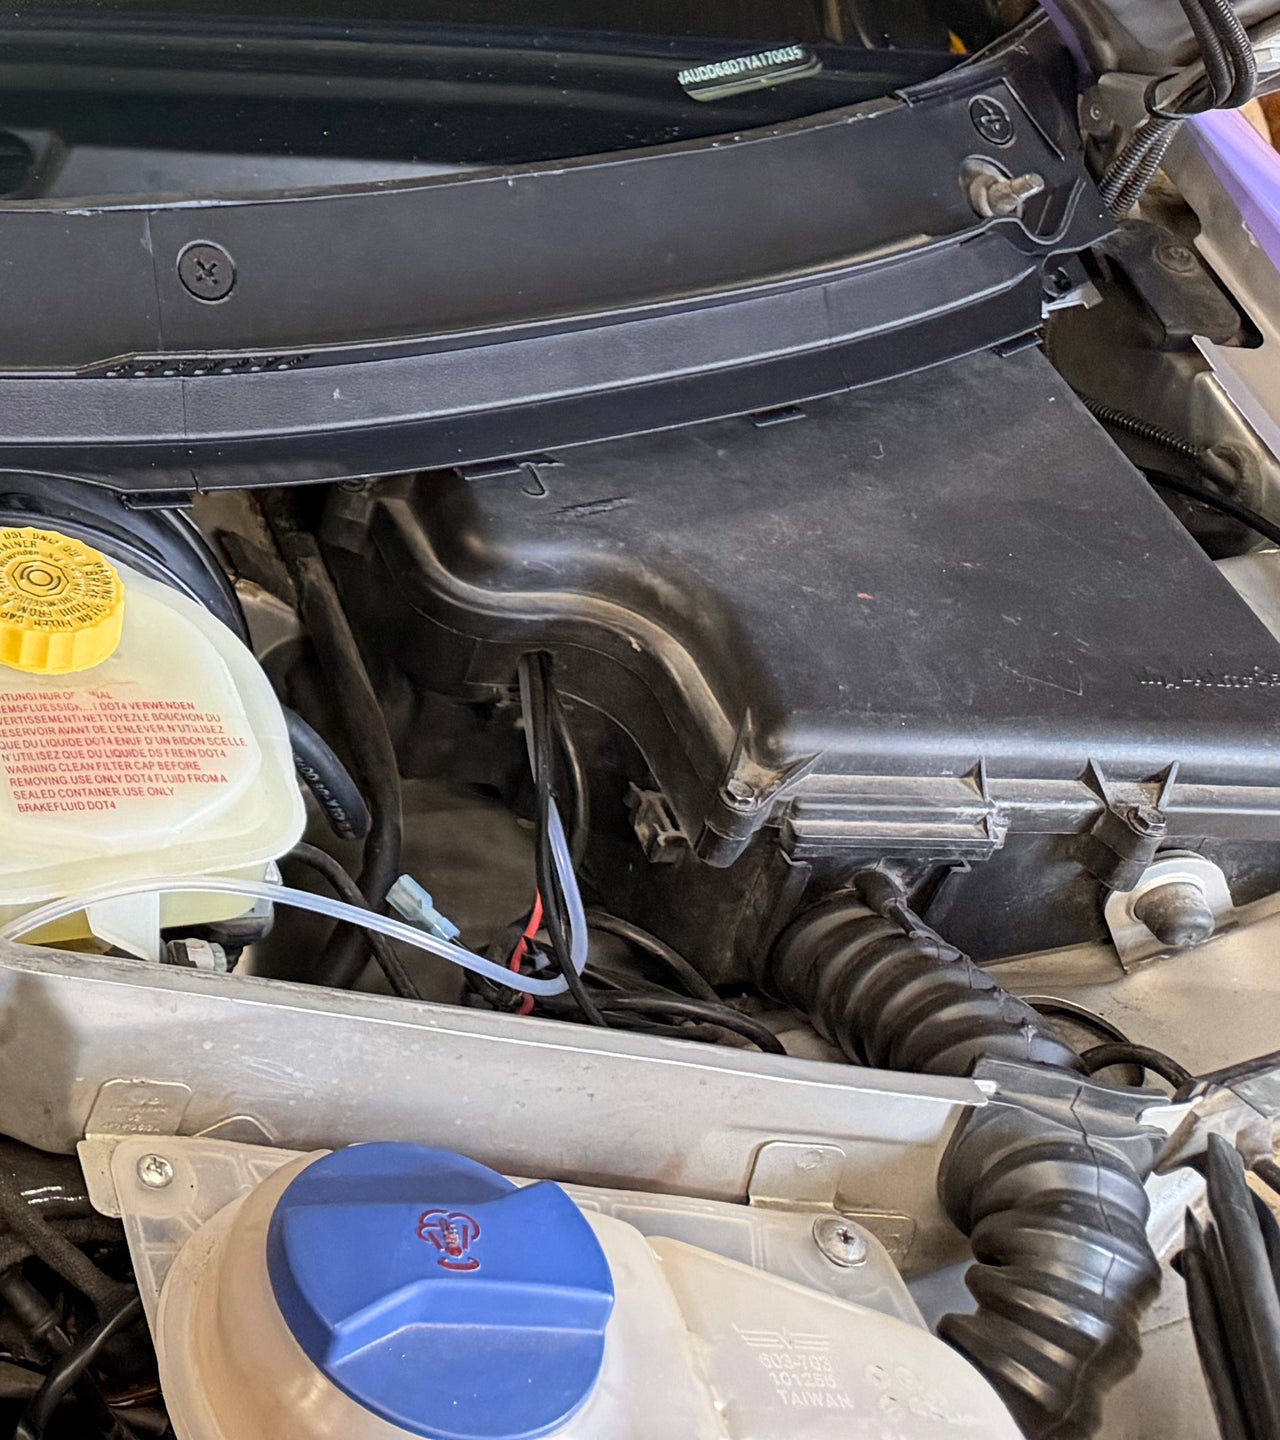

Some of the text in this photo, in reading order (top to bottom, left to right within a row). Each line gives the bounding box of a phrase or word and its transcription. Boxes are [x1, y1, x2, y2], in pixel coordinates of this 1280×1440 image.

[38, 691, 62, 701] NUR
[99, 702, 128, 711] DOT4
[128, 701, 195, 711] VERWENDEN
[151, 712, 204, 722] BOUCHON
[205, 713, 221, 722] DU
[57, 725, 91, 736] AVANT
[92, 725, 108, 735] DE
[23, 740, 39, 749] DU
[40, 738, 83, 748] LIQUIDE
[84, 737, 113, 747] DOT4
[172, 737, 206, 746] BIDON
[207, 737, 248, 747] SCELLE
[61, 750, 86, 760] QUE
[87, 749, 104, 759] DU
[104, 749, 148, 759] LIQUIDE
[165, 748, 198, 758] FREIN
[198, 748, 228, 758] DOT4
[5, 761, 202, 774] WARNING CLEAN FILTER CAP BEFORE
[94, 774, 123, 784] ONLY
[124, 774, 154, 783] DOT4
[154, 773, 187, 783] FLUID
[13, 788, 56, 800] SEALED
[146, 786, 175, 797] ONLY
[17, 800, 117, 813] BRAKEFLUID DOT4
[776, 1389, 854, 1409] TAIWAN
